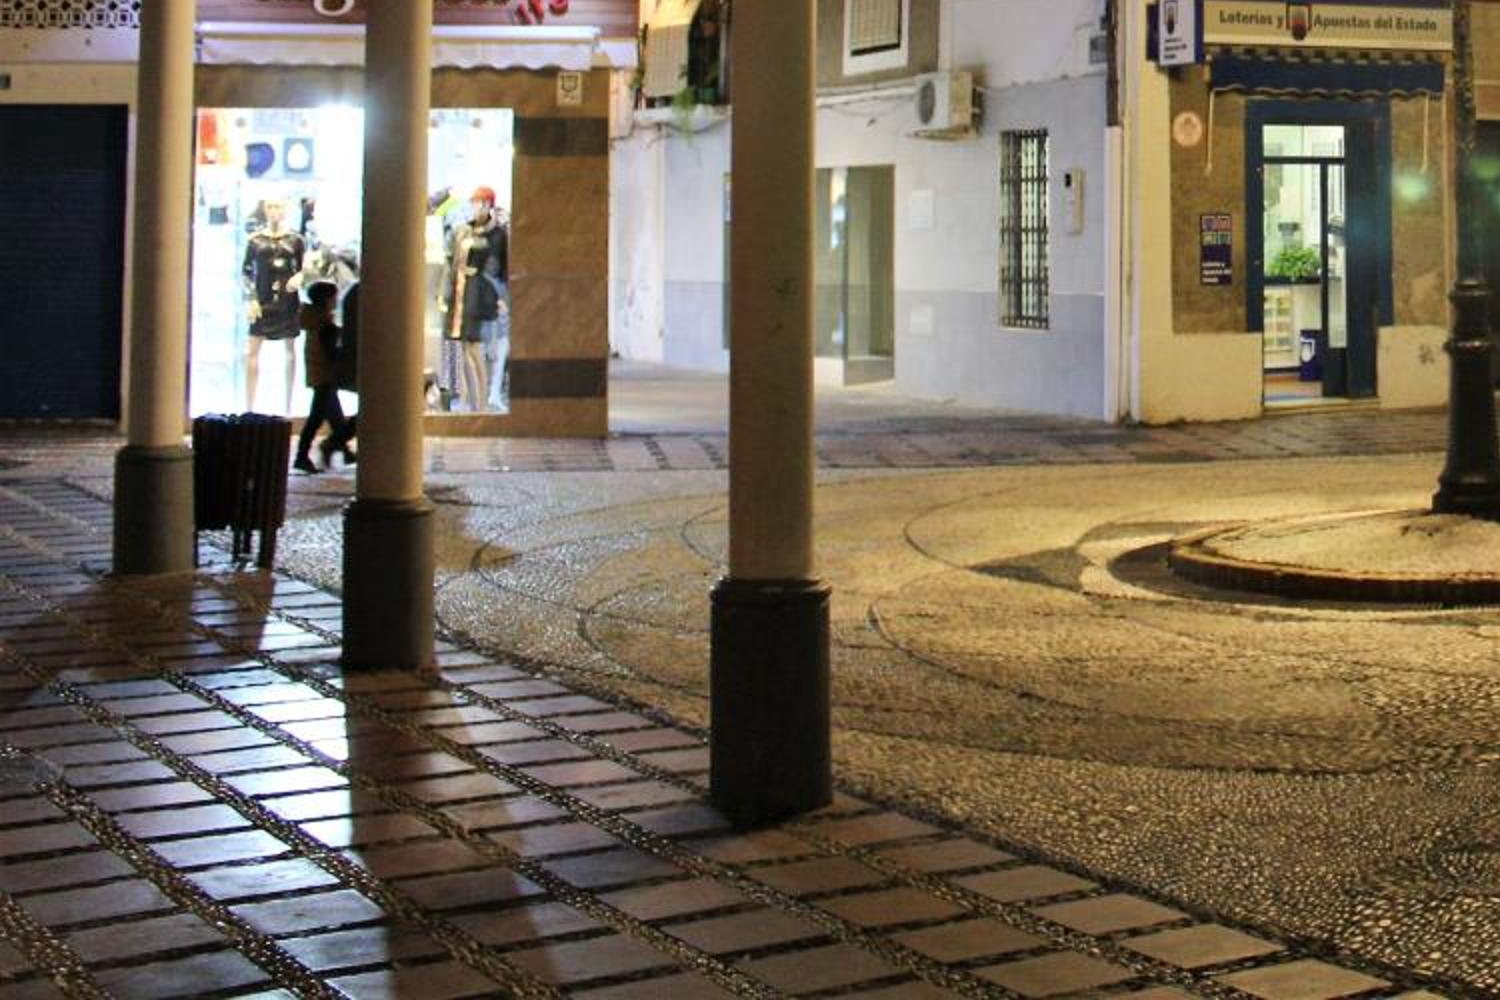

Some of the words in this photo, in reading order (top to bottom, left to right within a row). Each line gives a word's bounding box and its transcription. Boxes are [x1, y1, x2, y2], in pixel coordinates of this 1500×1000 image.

[1276, 15, 1283, 30] y
[1313, 14, 1370, 30] Apuestas
[1374, 16, 1393, 29] del
[1396, 18, 1437, 31] Estado
